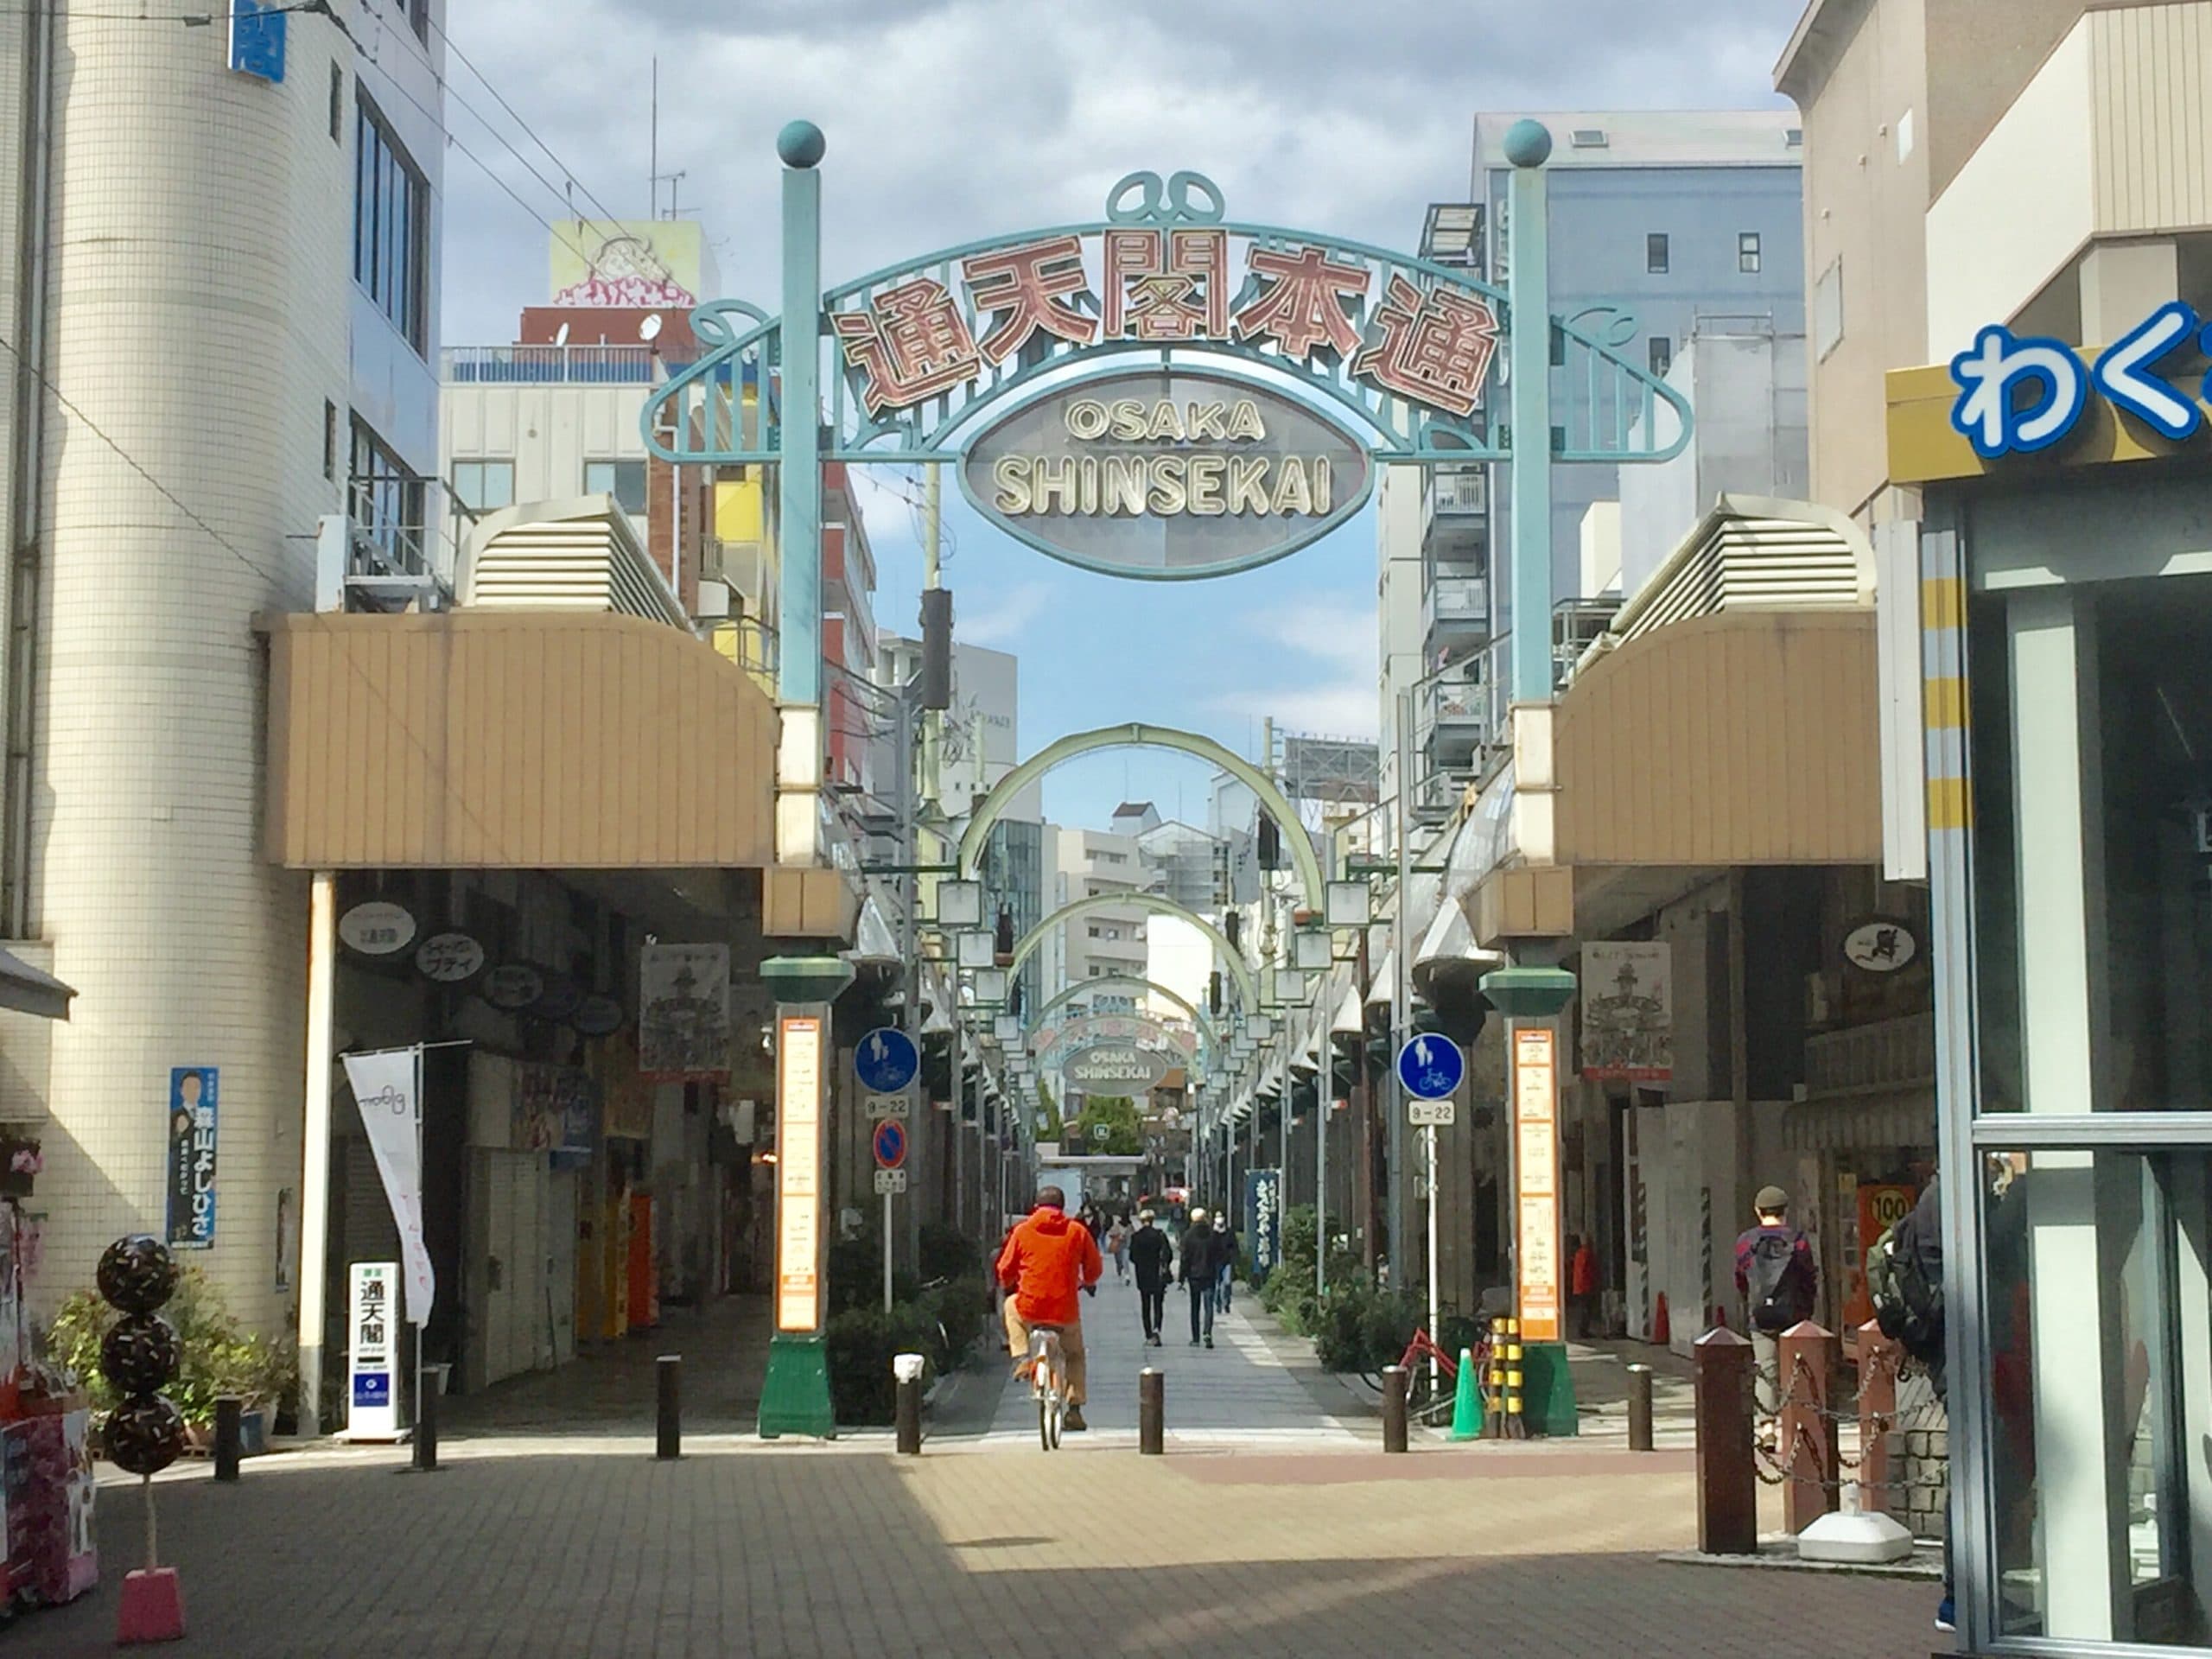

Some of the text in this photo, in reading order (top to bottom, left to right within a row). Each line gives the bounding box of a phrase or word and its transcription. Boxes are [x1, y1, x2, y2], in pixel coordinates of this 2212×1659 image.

[830, 228, 1502, 418] 通天閣本通
[1950, 301, 2212, 460] わく
[1064, 398, 1268, 442] OSAKA
[994, 454, 1332, 517] SHINSEKAI
[1074, 1065, 1151, 1080] SHINSEKAI
[1090, 1051, 1135, 1065] OSAKA
[1874, 1197, 1906, 1220] 100
[360, 1280, 385, 1344] 通天閣
